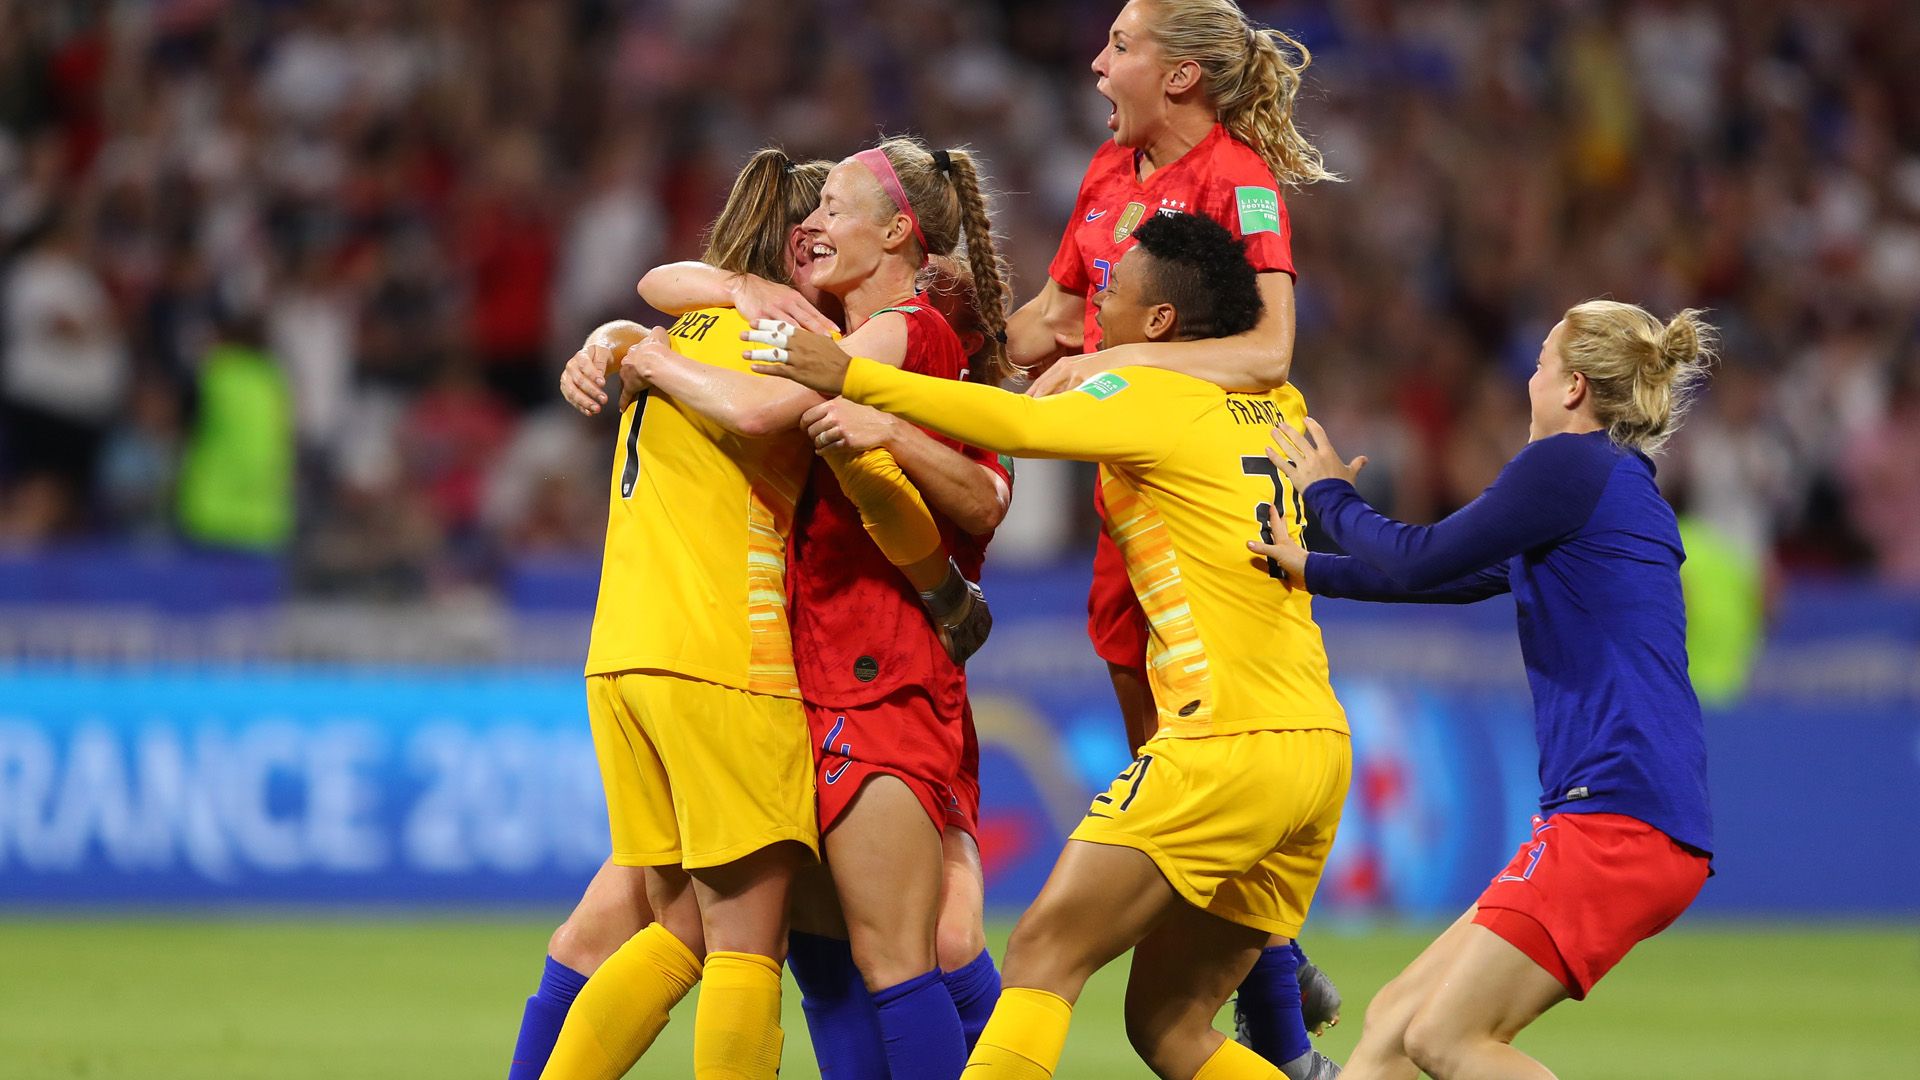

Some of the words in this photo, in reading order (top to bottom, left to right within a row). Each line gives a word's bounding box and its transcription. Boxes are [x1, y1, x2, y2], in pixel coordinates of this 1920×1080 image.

[1241, 203, 1276, 212] FOOTBALL
[1263, 212, 1277, 222] FIFA
[667, 311, 720, 341] HER
[621, 388, 649, 499] 1
